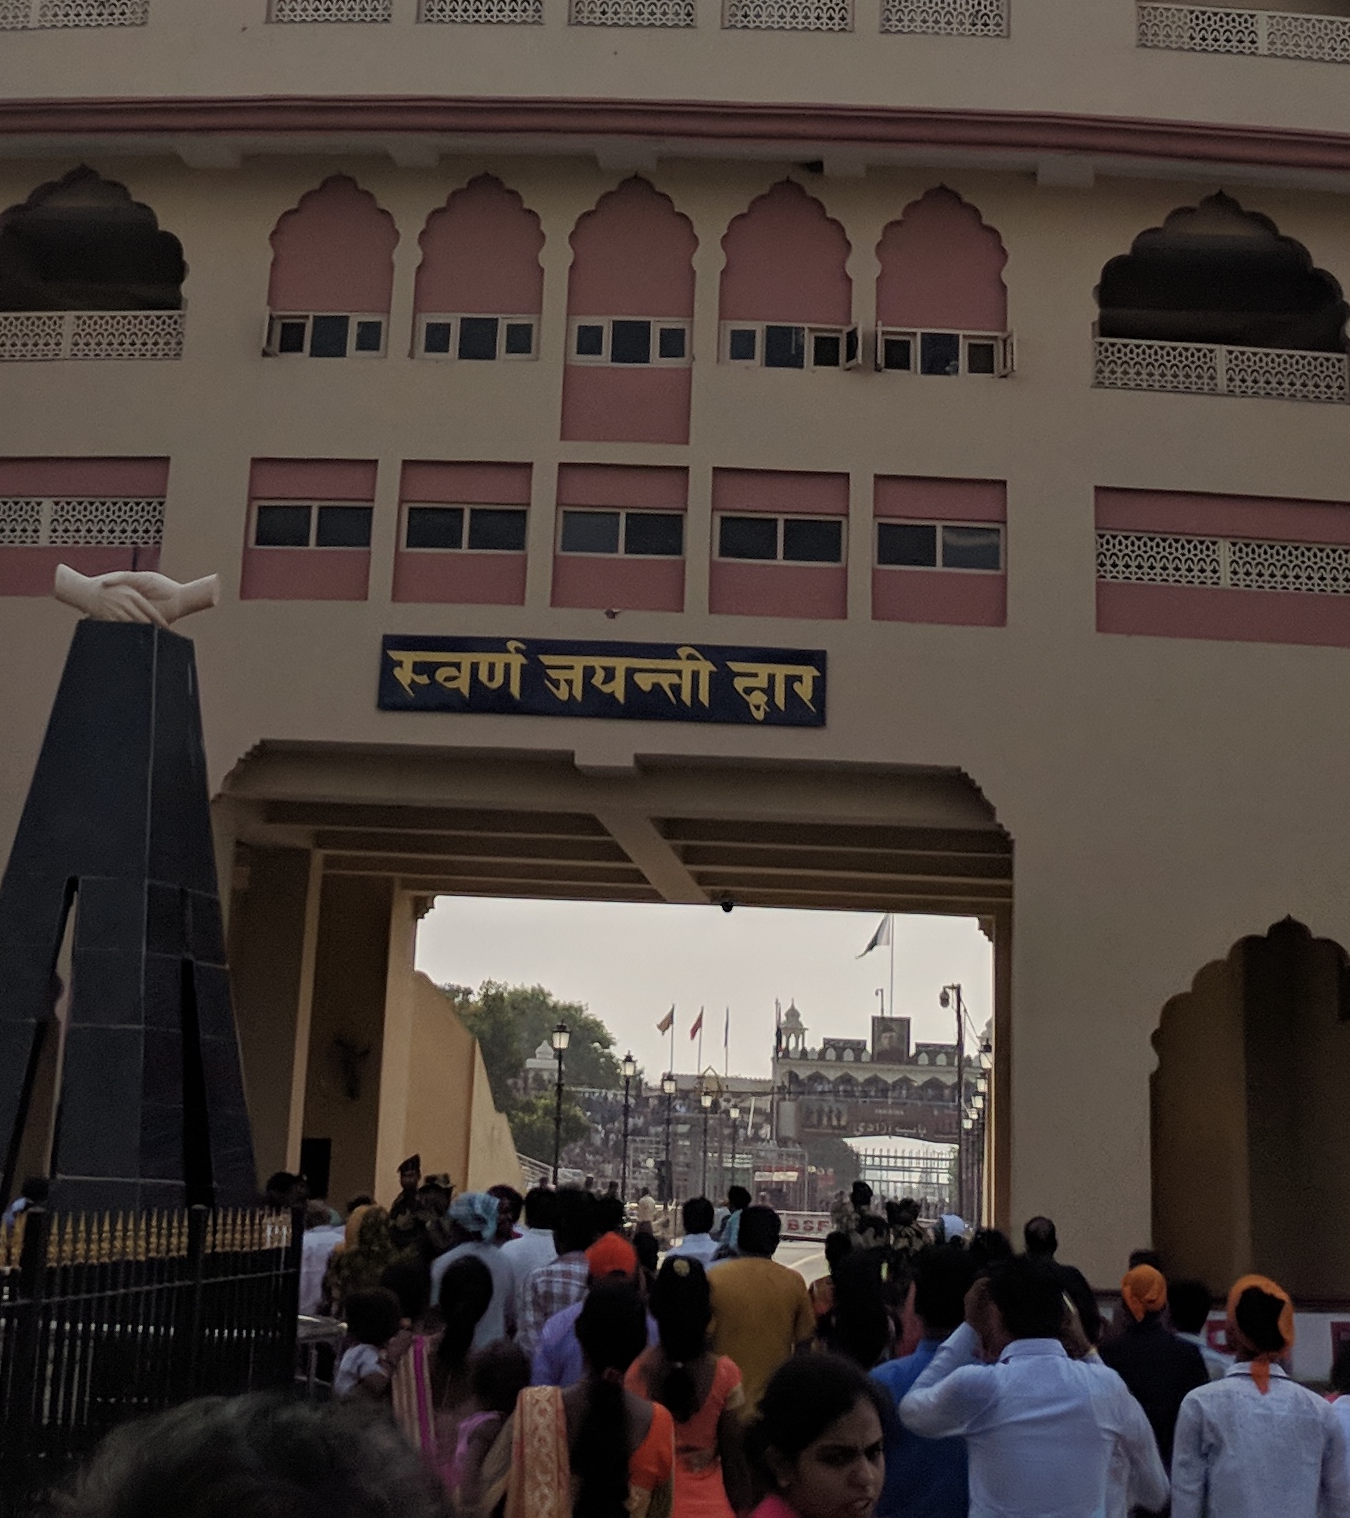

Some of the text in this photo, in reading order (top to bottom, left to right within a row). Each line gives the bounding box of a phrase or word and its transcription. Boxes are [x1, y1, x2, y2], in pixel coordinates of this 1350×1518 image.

[386, 639, 822, 722] स्वर्ण जयन्ती द्वार
[786, 1218, 832, 1233] BSF
